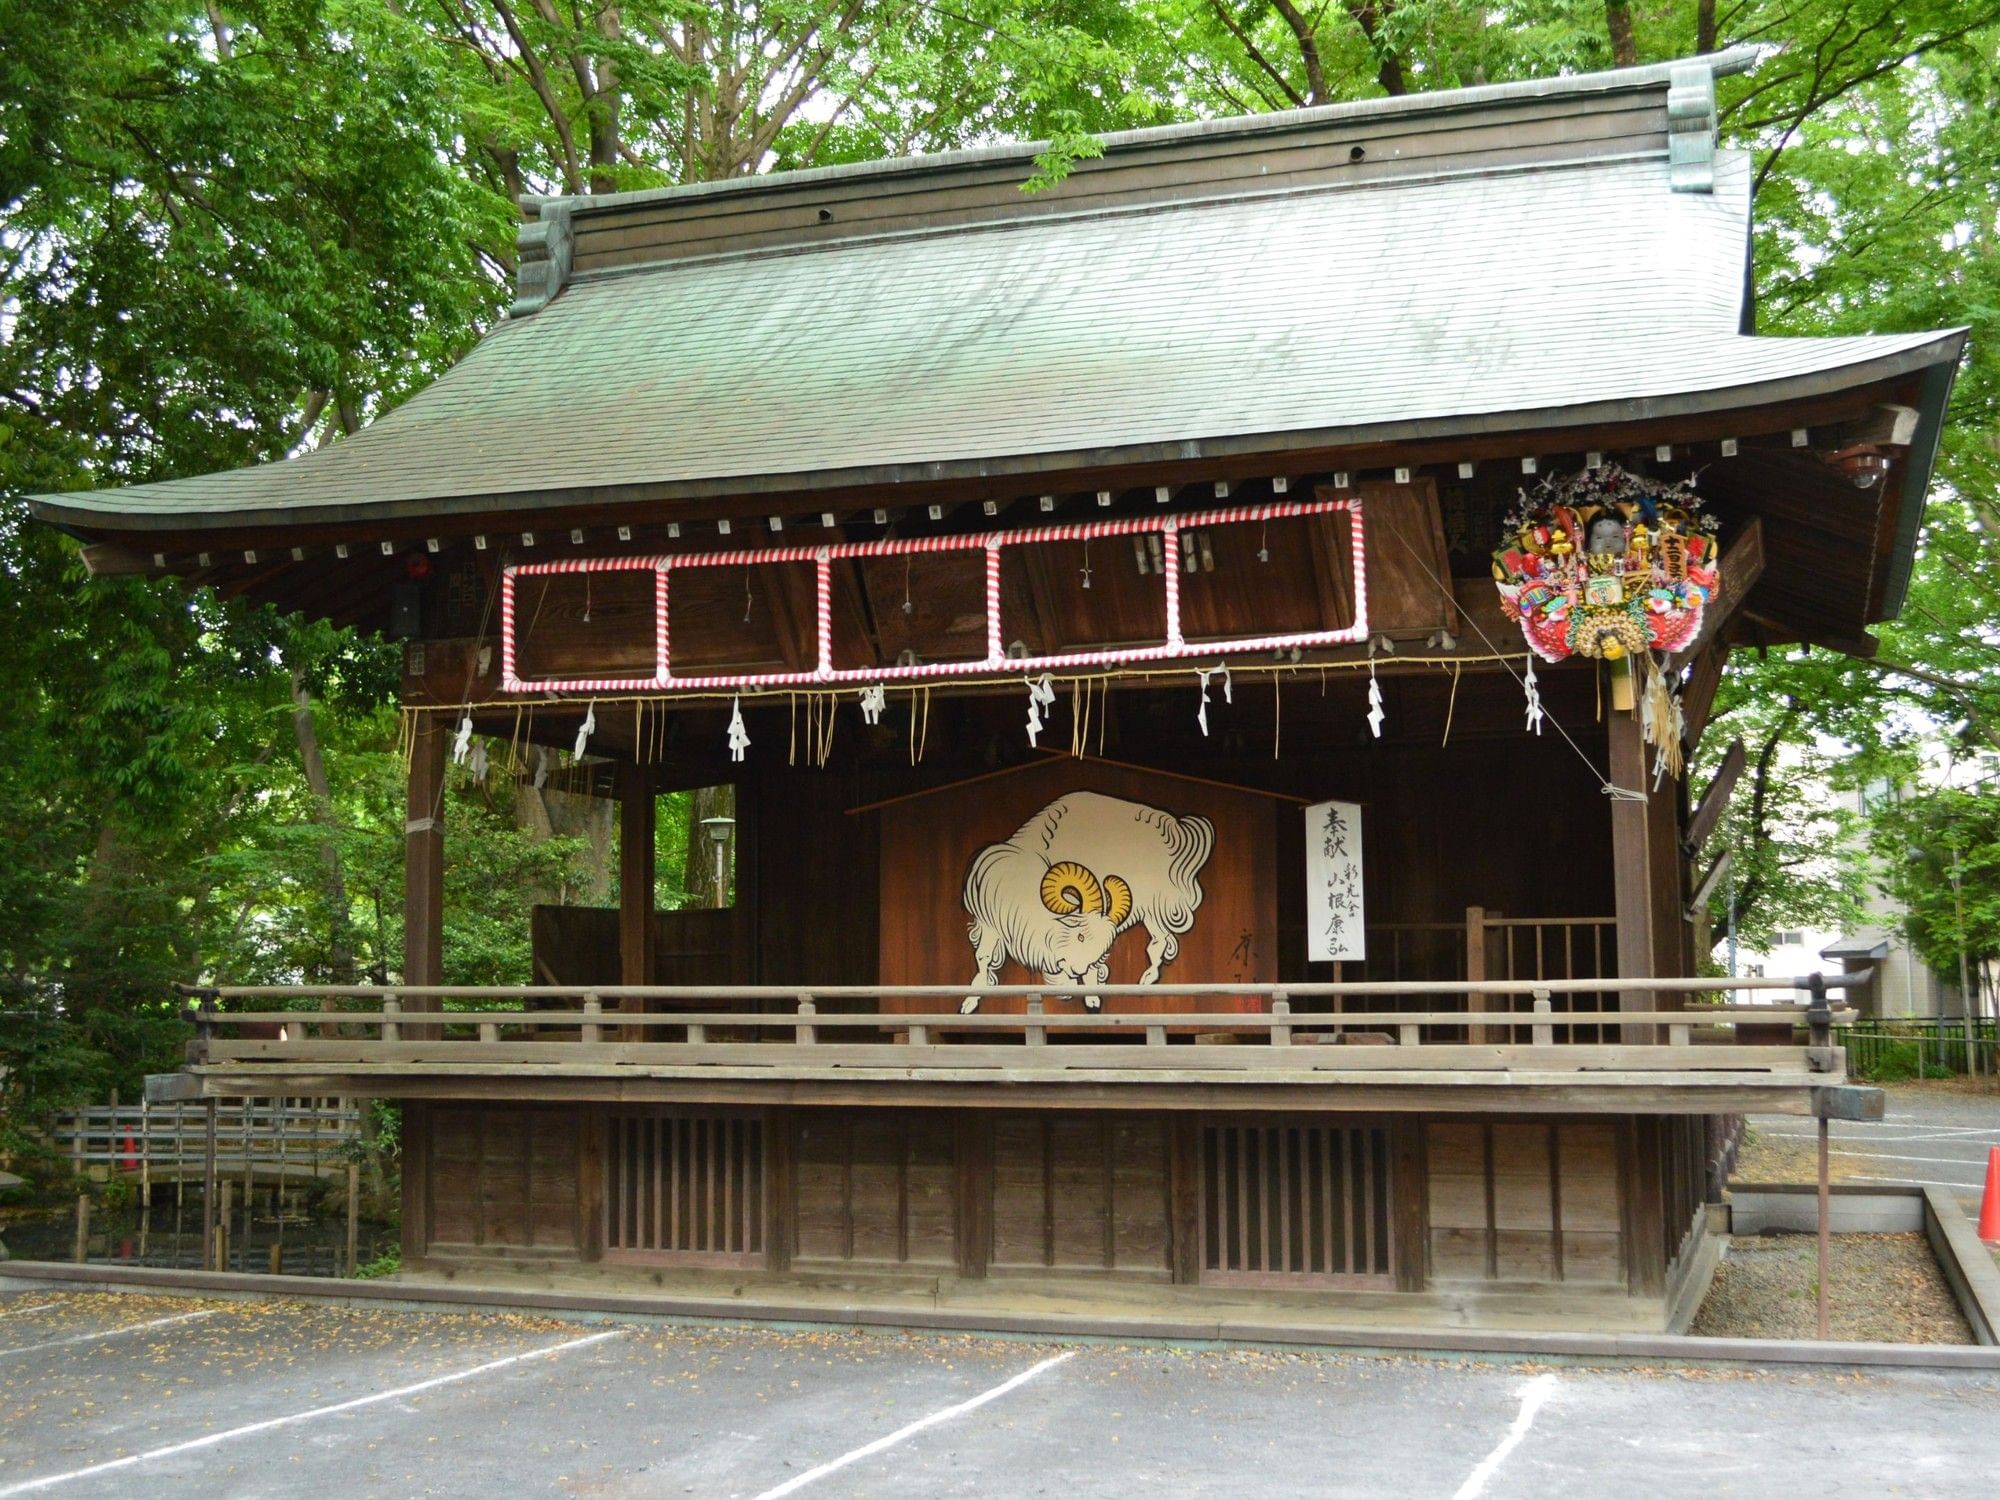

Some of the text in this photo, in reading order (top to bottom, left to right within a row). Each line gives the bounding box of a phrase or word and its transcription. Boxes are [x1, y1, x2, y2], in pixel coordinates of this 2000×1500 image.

[1322, 807, 1348, 859] 奉献
[1325, 871, 1349, 956] 山根康弘
